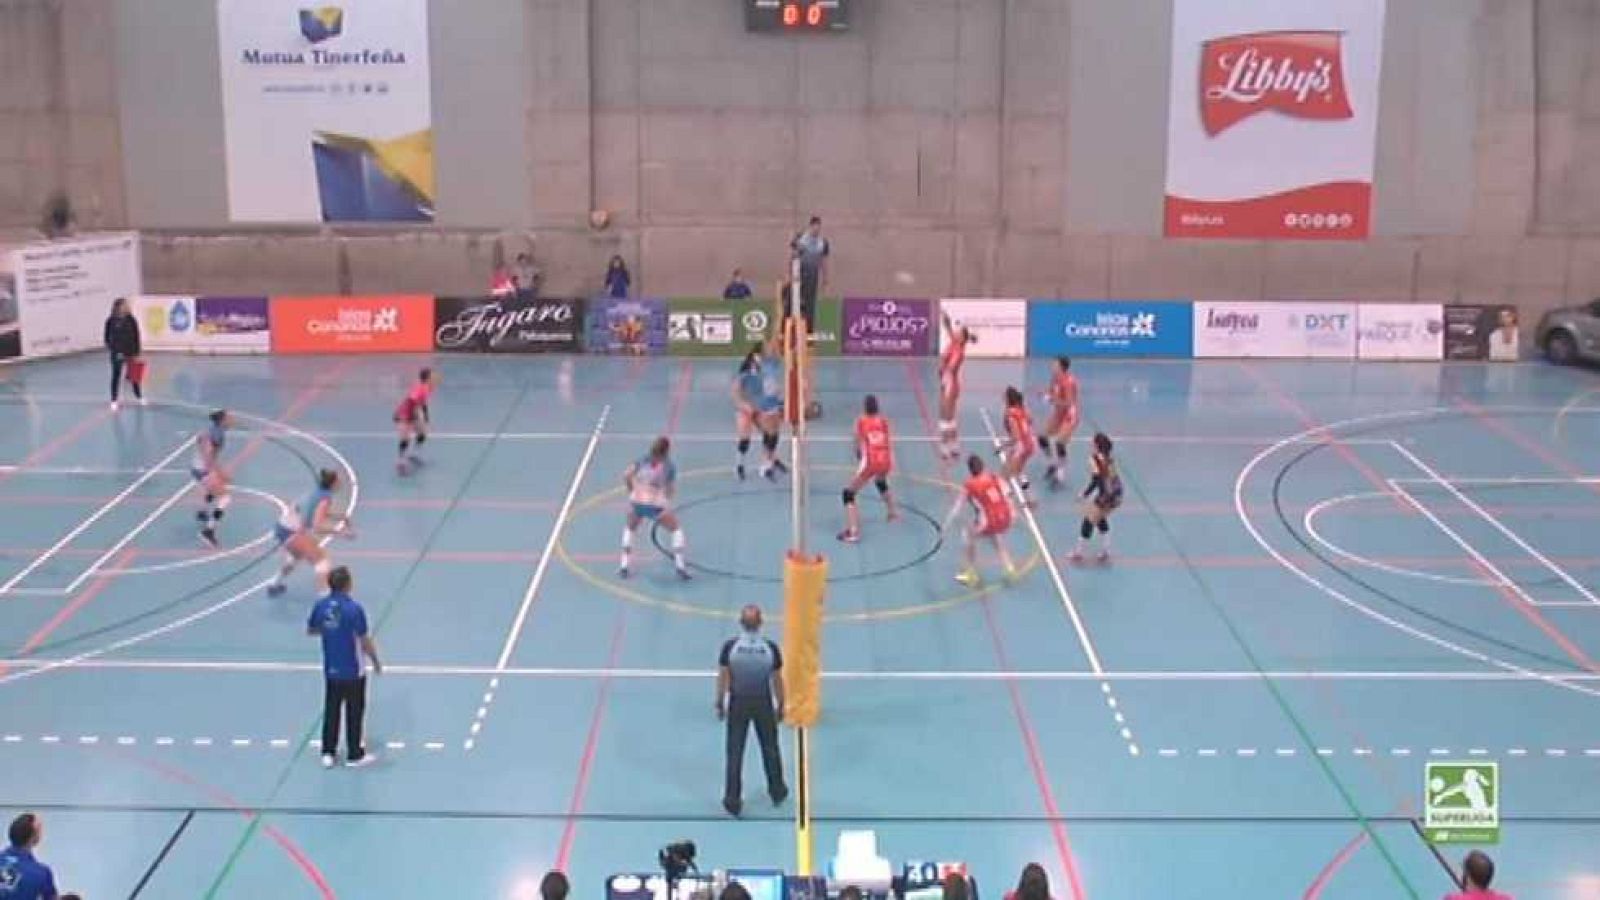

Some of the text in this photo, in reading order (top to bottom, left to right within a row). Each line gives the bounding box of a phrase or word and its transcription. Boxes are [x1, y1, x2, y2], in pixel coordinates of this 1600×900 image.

[243, 49, 406, 64] Mutua Tinerfeña
[1206, 48, 1332, 103] Libby's
[1305, 313, 1348, 330] DXT
